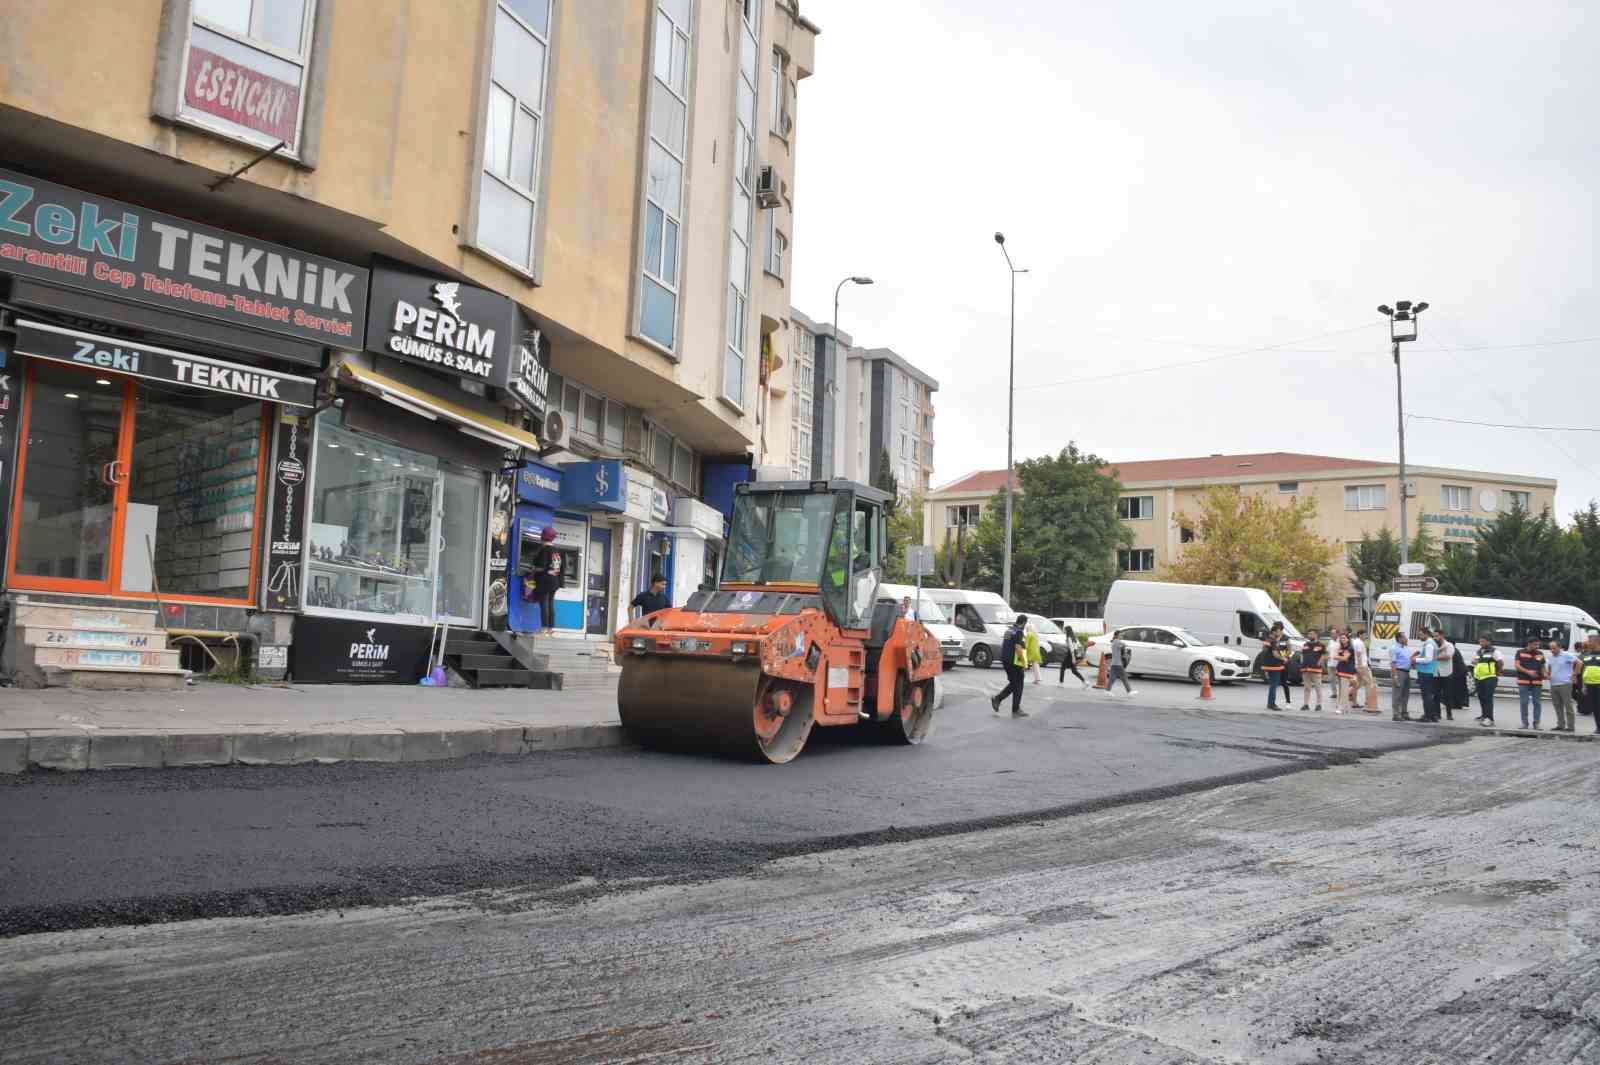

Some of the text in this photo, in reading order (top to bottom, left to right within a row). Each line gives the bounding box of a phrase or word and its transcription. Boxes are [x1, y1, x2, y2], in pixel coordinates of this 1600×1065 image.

[194, 60, 287, 125] ESENCAN
[0, 180, 139, 262] Zeki
[0, 243, 87, 276] arantili
[73, 340, 140, 372] Zeki
[444, 351, 455, 367] &
[456, 355, 493, 377] SAAT
